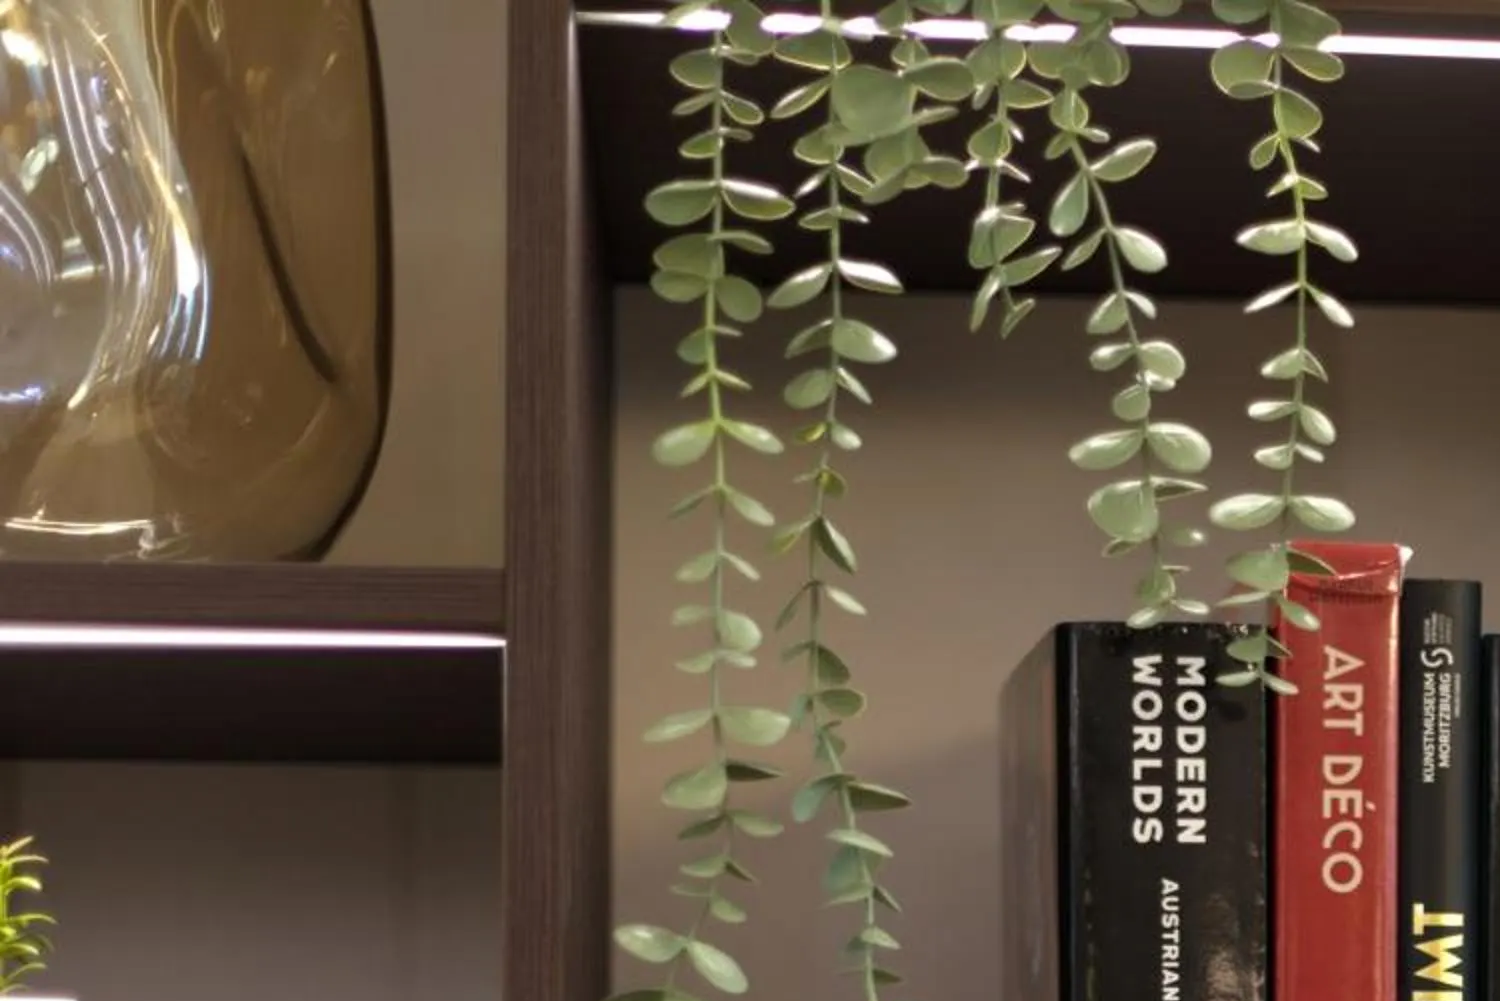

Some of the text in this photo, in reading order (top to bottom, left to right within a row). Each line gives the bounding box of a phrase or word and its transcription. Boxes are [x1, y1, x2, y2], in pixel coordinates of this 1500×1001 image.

[1131, 655, 1164, 844] WORLDS
[1175, 656, 1207, 844] MODERN
[1321, 645, 1376, 894] ART DÉCO
[1422, 672, 1436, 783] KUNSTMUSEUM
[1438, 672, 1452, 768] MORITZBURG
[1160, 878, 1180, 1001] AUSTRIAN
